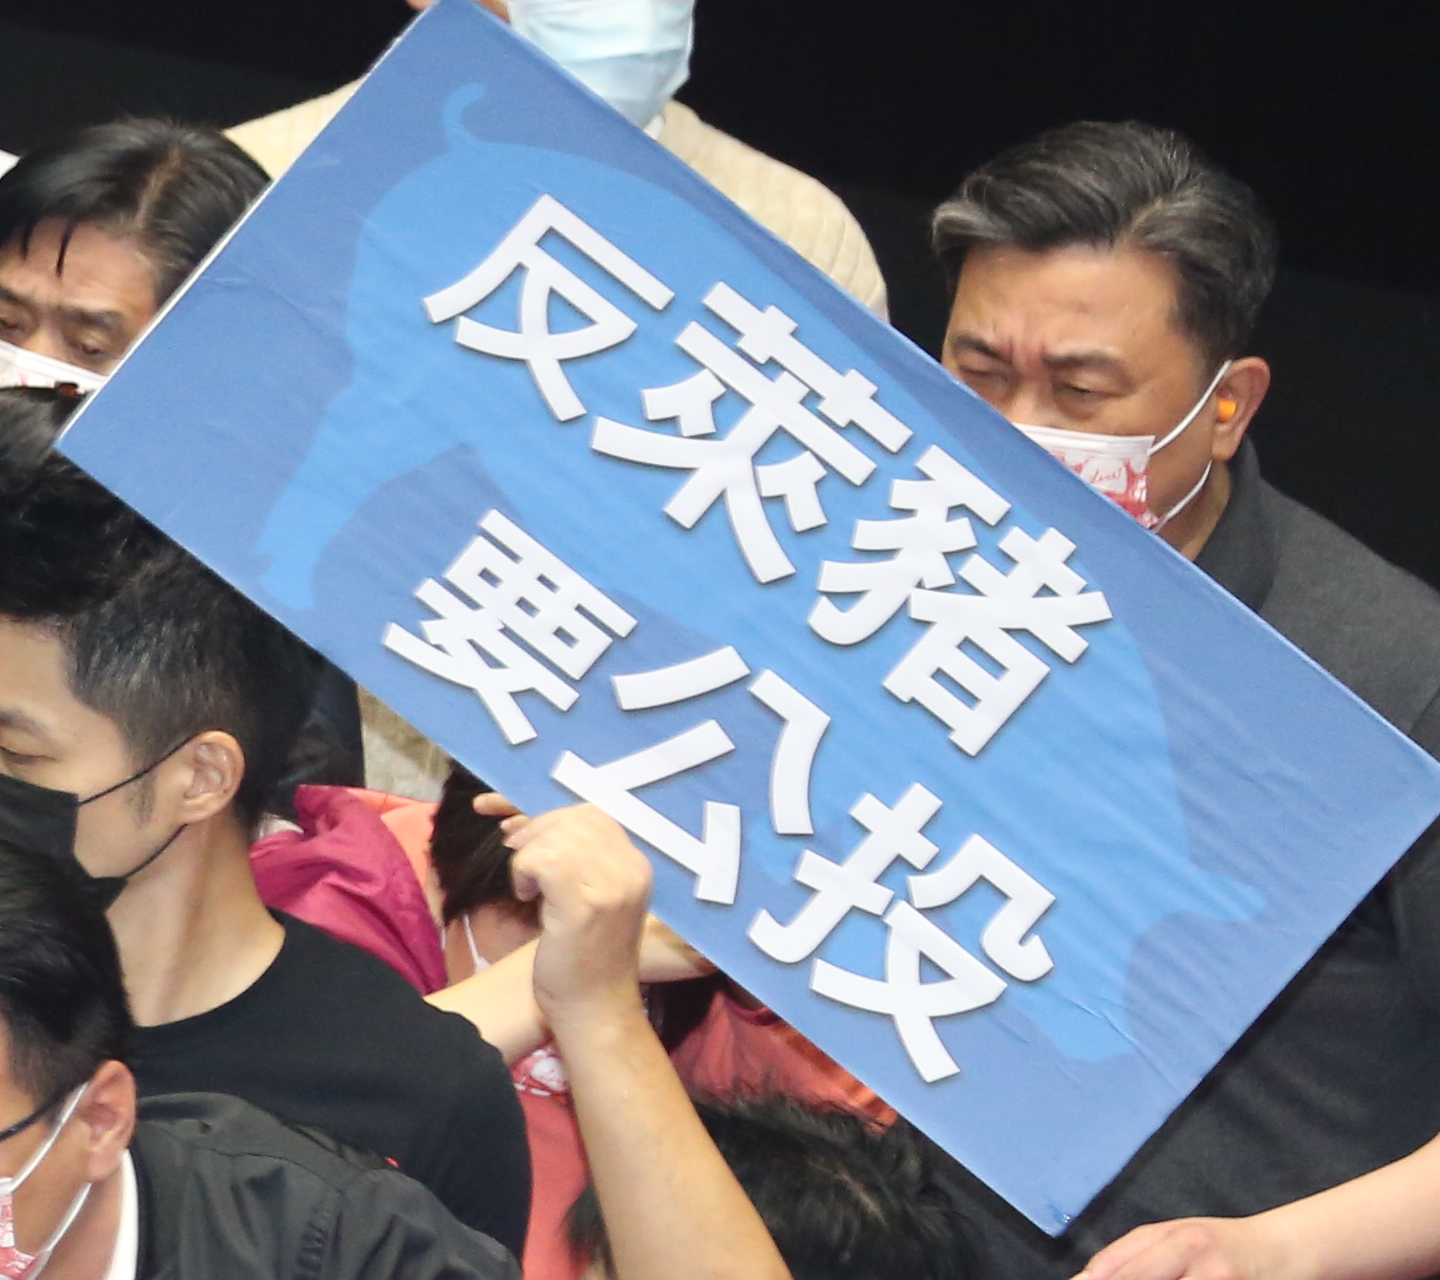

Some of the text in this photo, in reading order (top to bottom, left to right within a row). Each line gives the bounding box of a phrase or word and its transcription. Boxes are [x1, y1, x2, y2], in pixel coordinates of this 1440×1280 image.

[422, 194, 1113, 758] 反萊豬
[383, 509, 1055, 1083] 要公投
